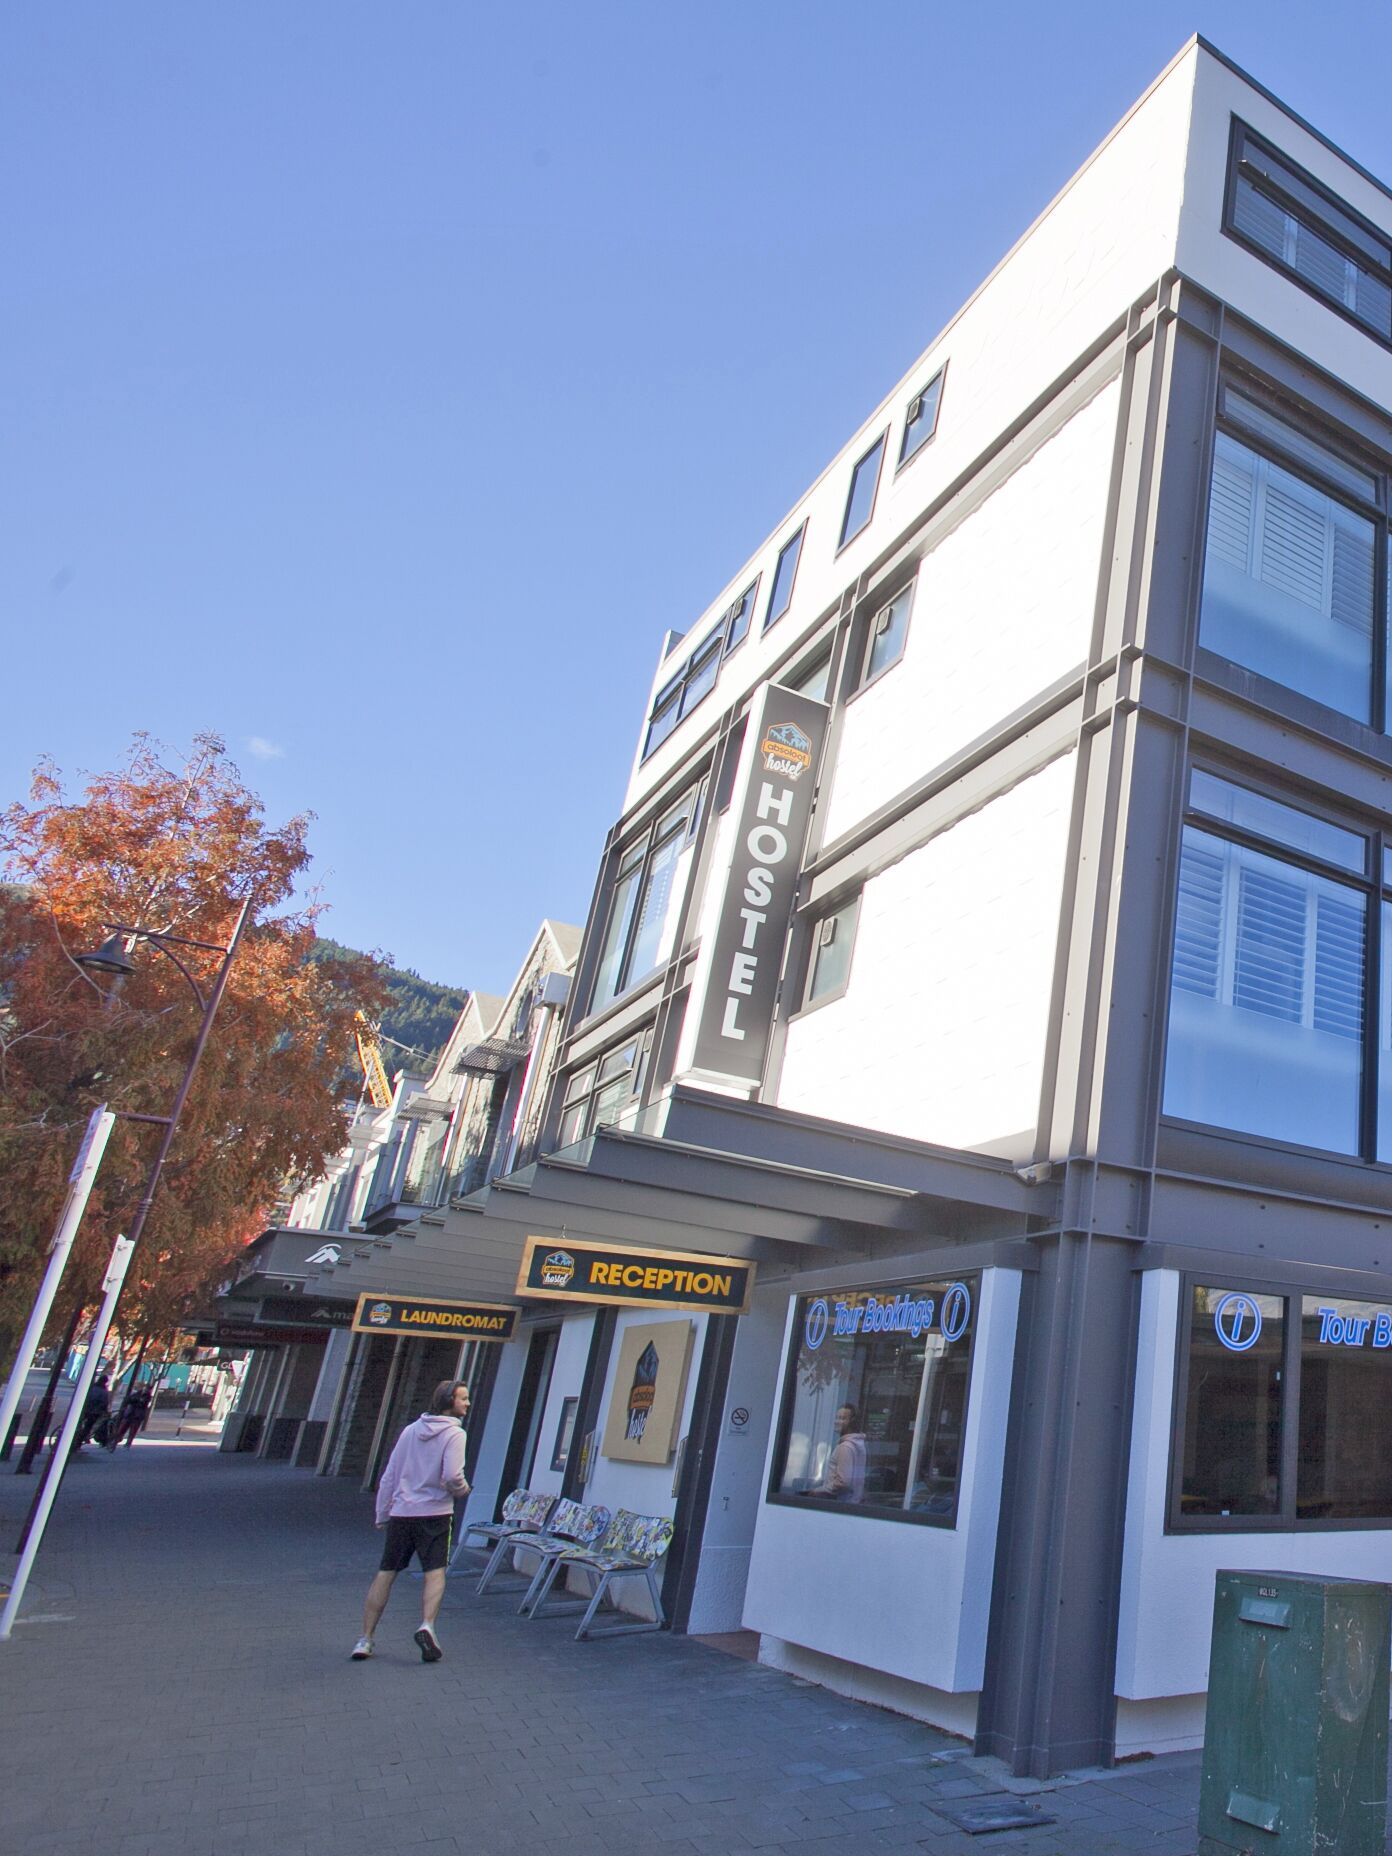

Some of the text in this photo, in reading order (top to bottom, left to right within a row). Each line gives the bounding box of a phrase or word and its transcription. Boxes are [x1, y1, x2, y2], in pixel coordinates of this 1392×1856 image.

[766, 752, 803, 777] hostel
[720, 781, 794, 1041] HOSTEL
[589, 1262, 732, 1297] RECEPTION
[400, 1309, 508, 1330] LAUNDROMAT
[832, 1301, 864, 1336] Tour
[862, 1294, 934, 1338] Bookings
[1318, 1306, 1370, 1346] Tour
